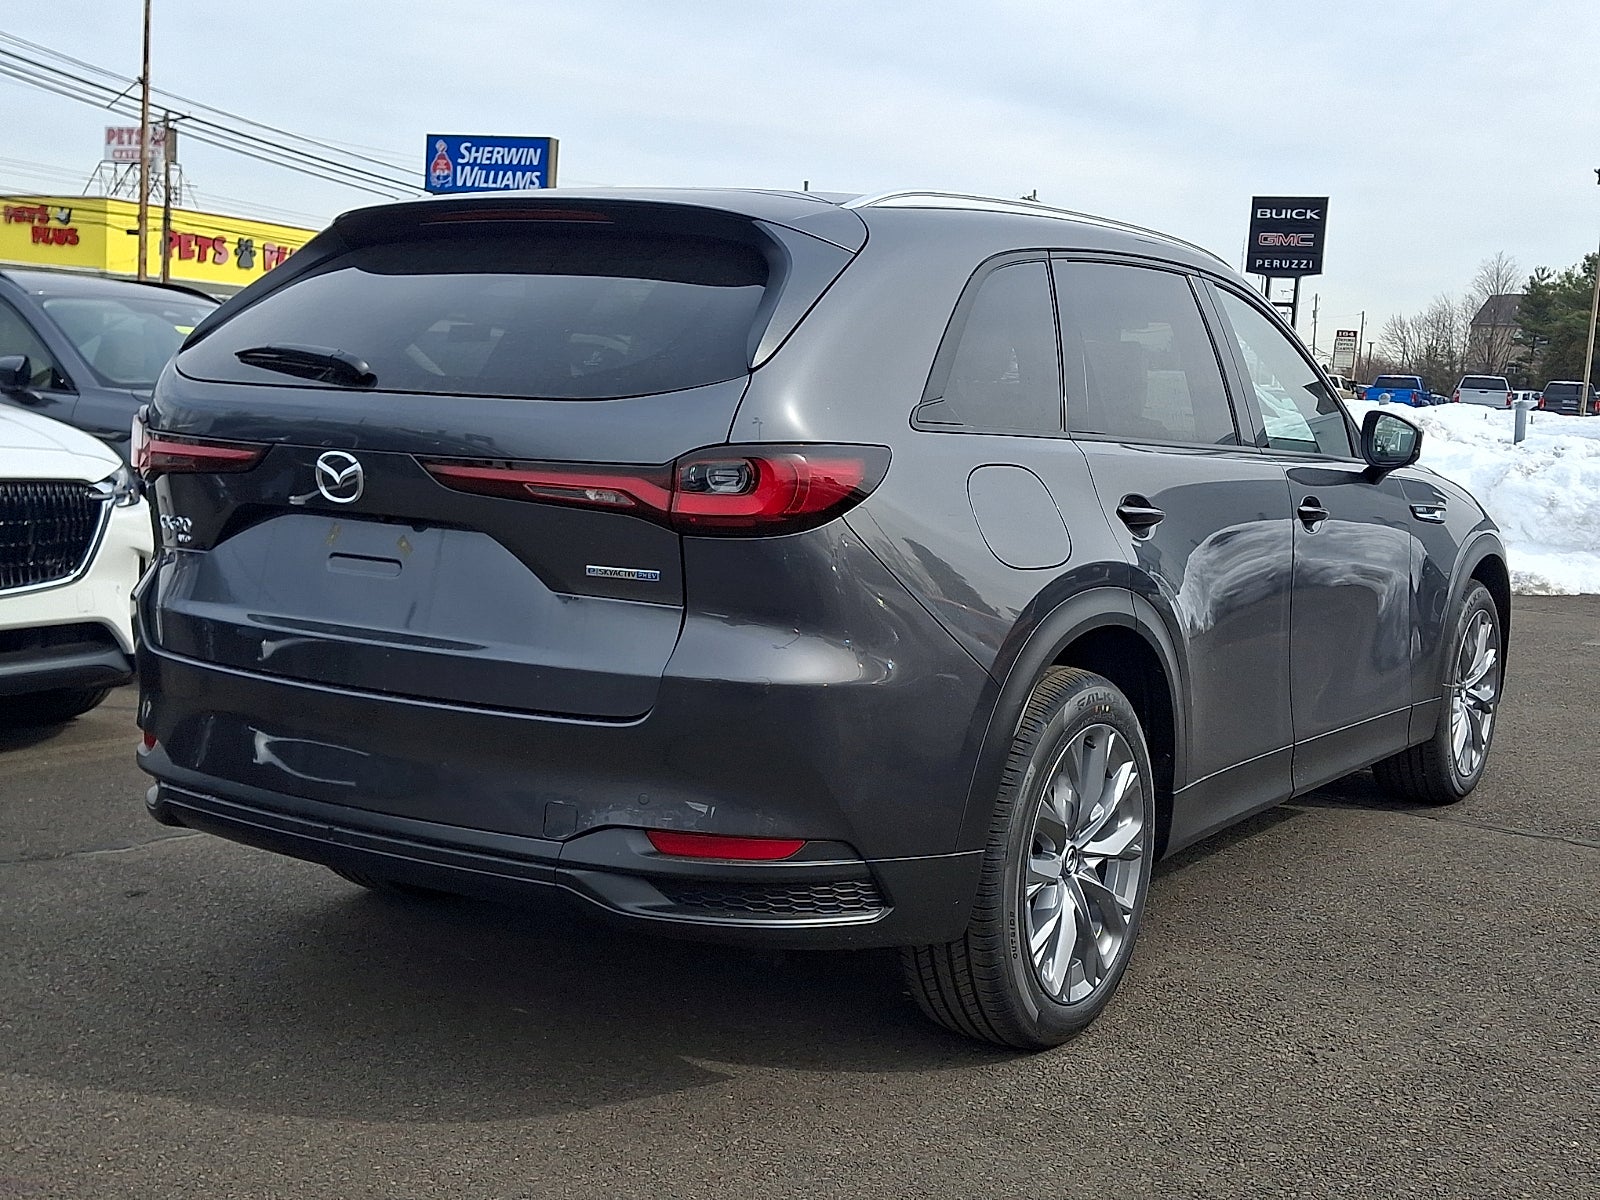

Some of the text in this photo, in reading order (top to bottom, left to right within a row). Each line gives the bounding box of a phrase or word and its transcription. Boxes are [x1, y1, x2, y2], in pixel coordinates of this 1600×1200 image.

[457, 142, 541, 165] SHERWIN
[456, 165, 541, 189] WILLIAMS
[4, 205, 50, 223] PETS
[1256, 208, 1320, 220] BUICK
[32, 226, 80, 245] PLUS
[1258, 232, 1315, 247] GMC
[168, 230, 229, 265] PETS
[1255, 259, 1314, 269] PERUZZI
